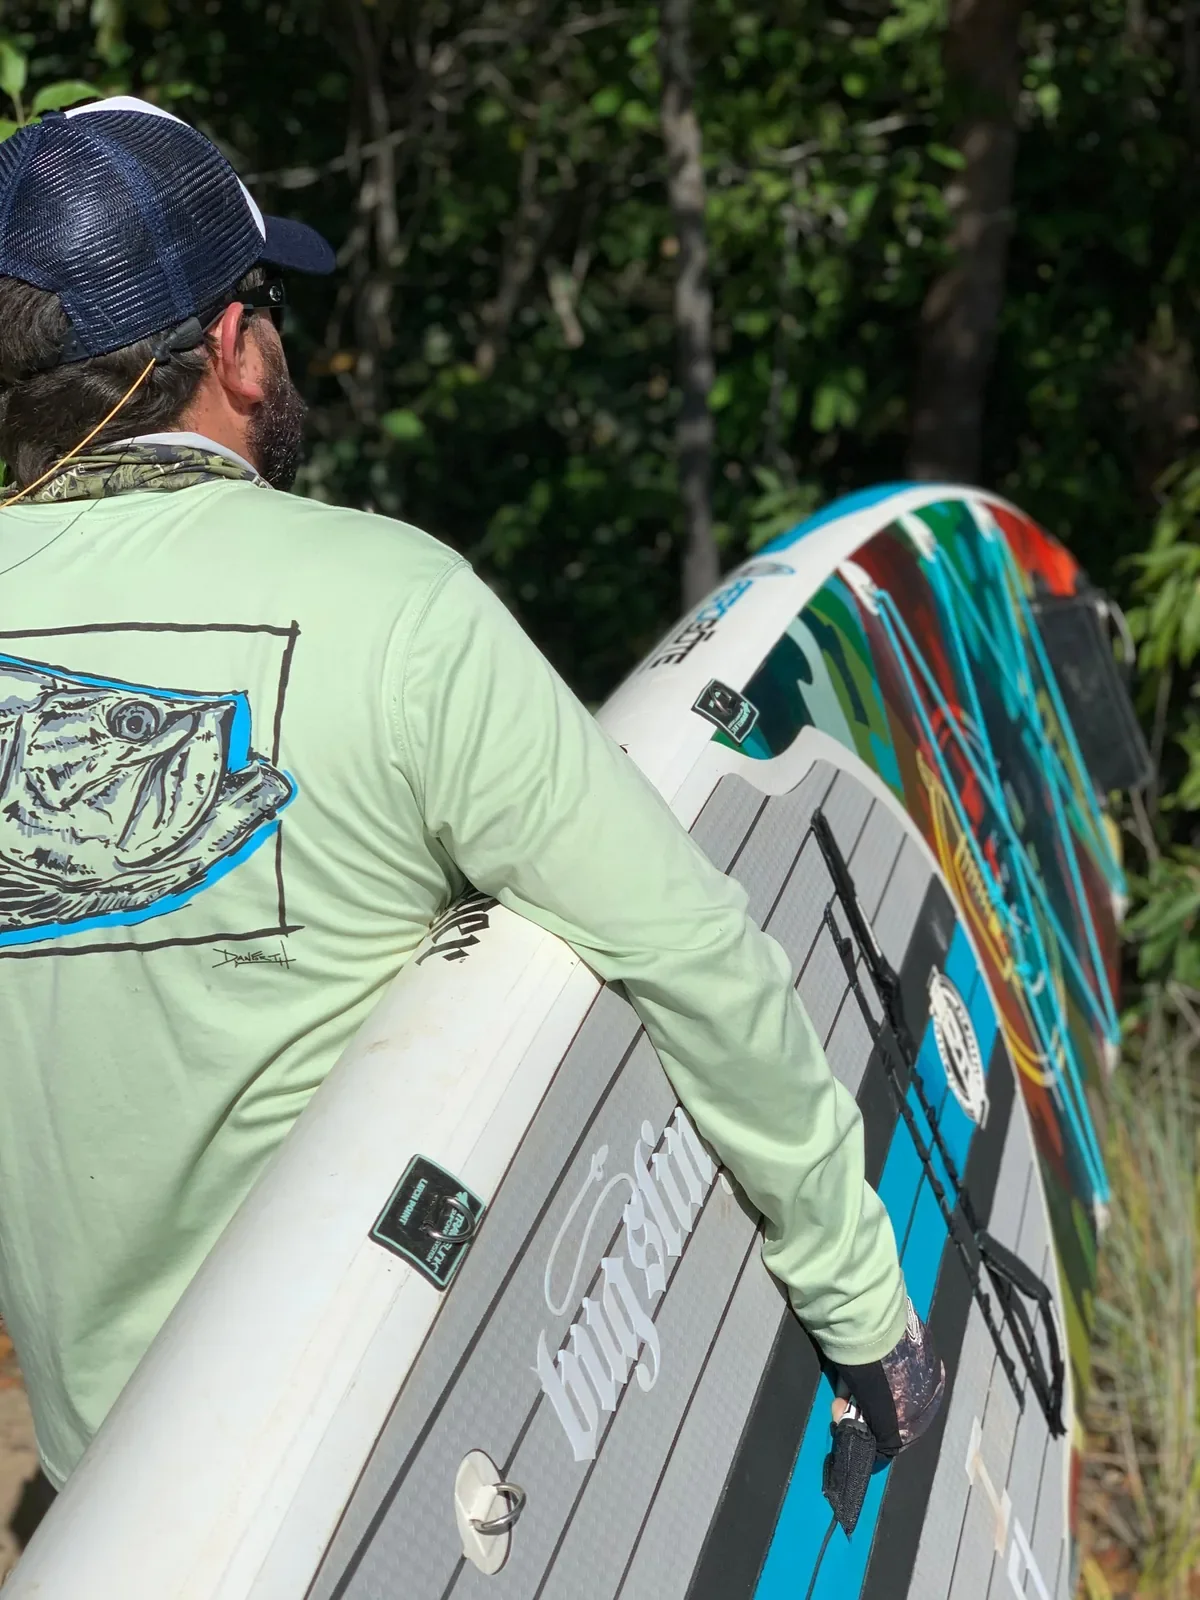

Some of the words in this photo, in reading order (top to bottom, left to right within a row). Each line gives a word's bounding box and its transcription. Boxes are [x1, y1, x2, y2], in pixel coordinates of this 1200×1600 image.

[410, 1177, 429, 1203] LATCH
[398, 1200, 417, 1226] POINT
[529, 1106, 715, 1463] bugslin
